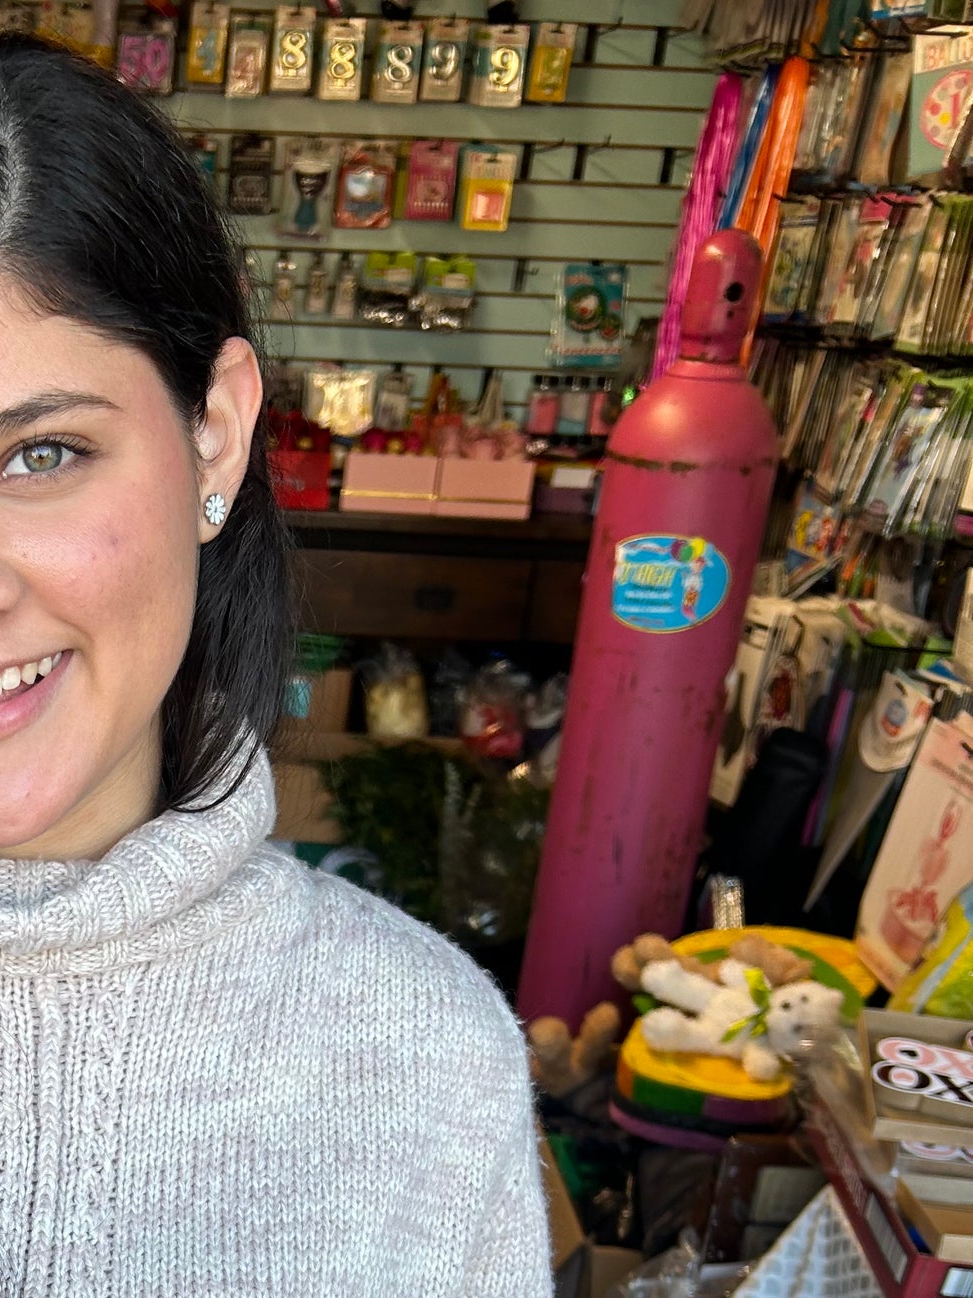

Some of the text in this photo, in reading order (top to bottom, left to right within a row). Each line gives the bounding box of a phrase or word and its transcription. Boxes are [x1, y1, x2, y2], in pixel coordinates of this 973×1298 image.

[281, 31, 307, 69] 8
[328, 41, 355, 79] 8
[385, 45, 413, 82] 8
[429, 42, 460, 81] 9
[489, 47, 520, 85] 9
